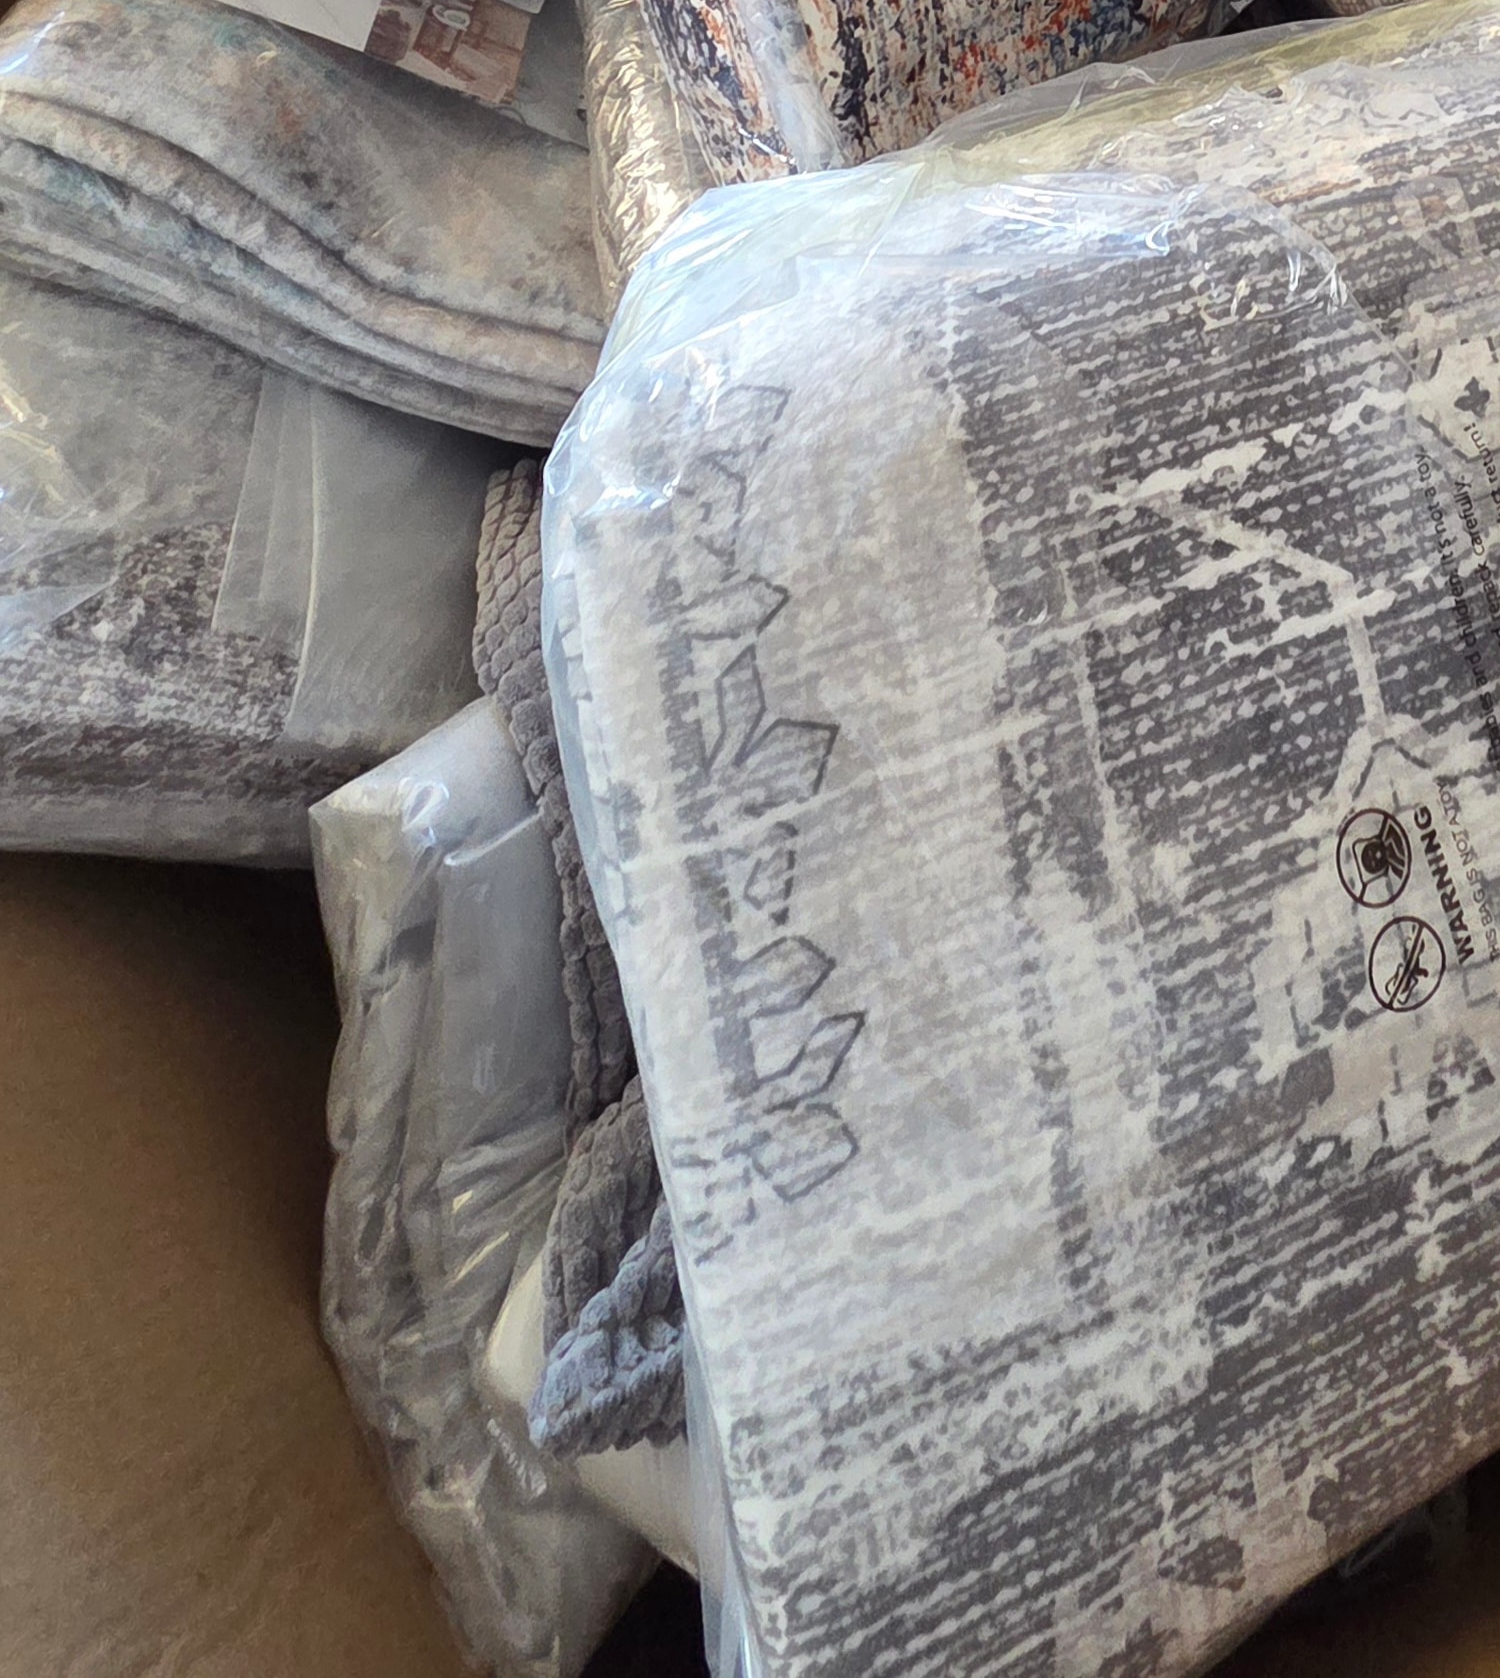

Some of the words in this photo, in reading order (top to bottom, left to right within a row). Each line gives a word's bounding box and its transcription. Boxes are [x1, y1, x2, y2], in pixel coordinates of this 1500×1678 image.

[1462, 420, 1500, 485] return!
[1423, 482, 1437, 497] a
[1424, 497, 1447, 534] not
[1435, 779, 1456, 816] TOY
[1447, 814, 1459, 826] A
[1451, 828, 1474, 865] NOT
[1414, 805, 1476, 965] WARNING
[1464, 867, 1481, 885] IS
[1471, 888, 1493, 926] BAG
[1483, 927, 1500, 962] THIS
